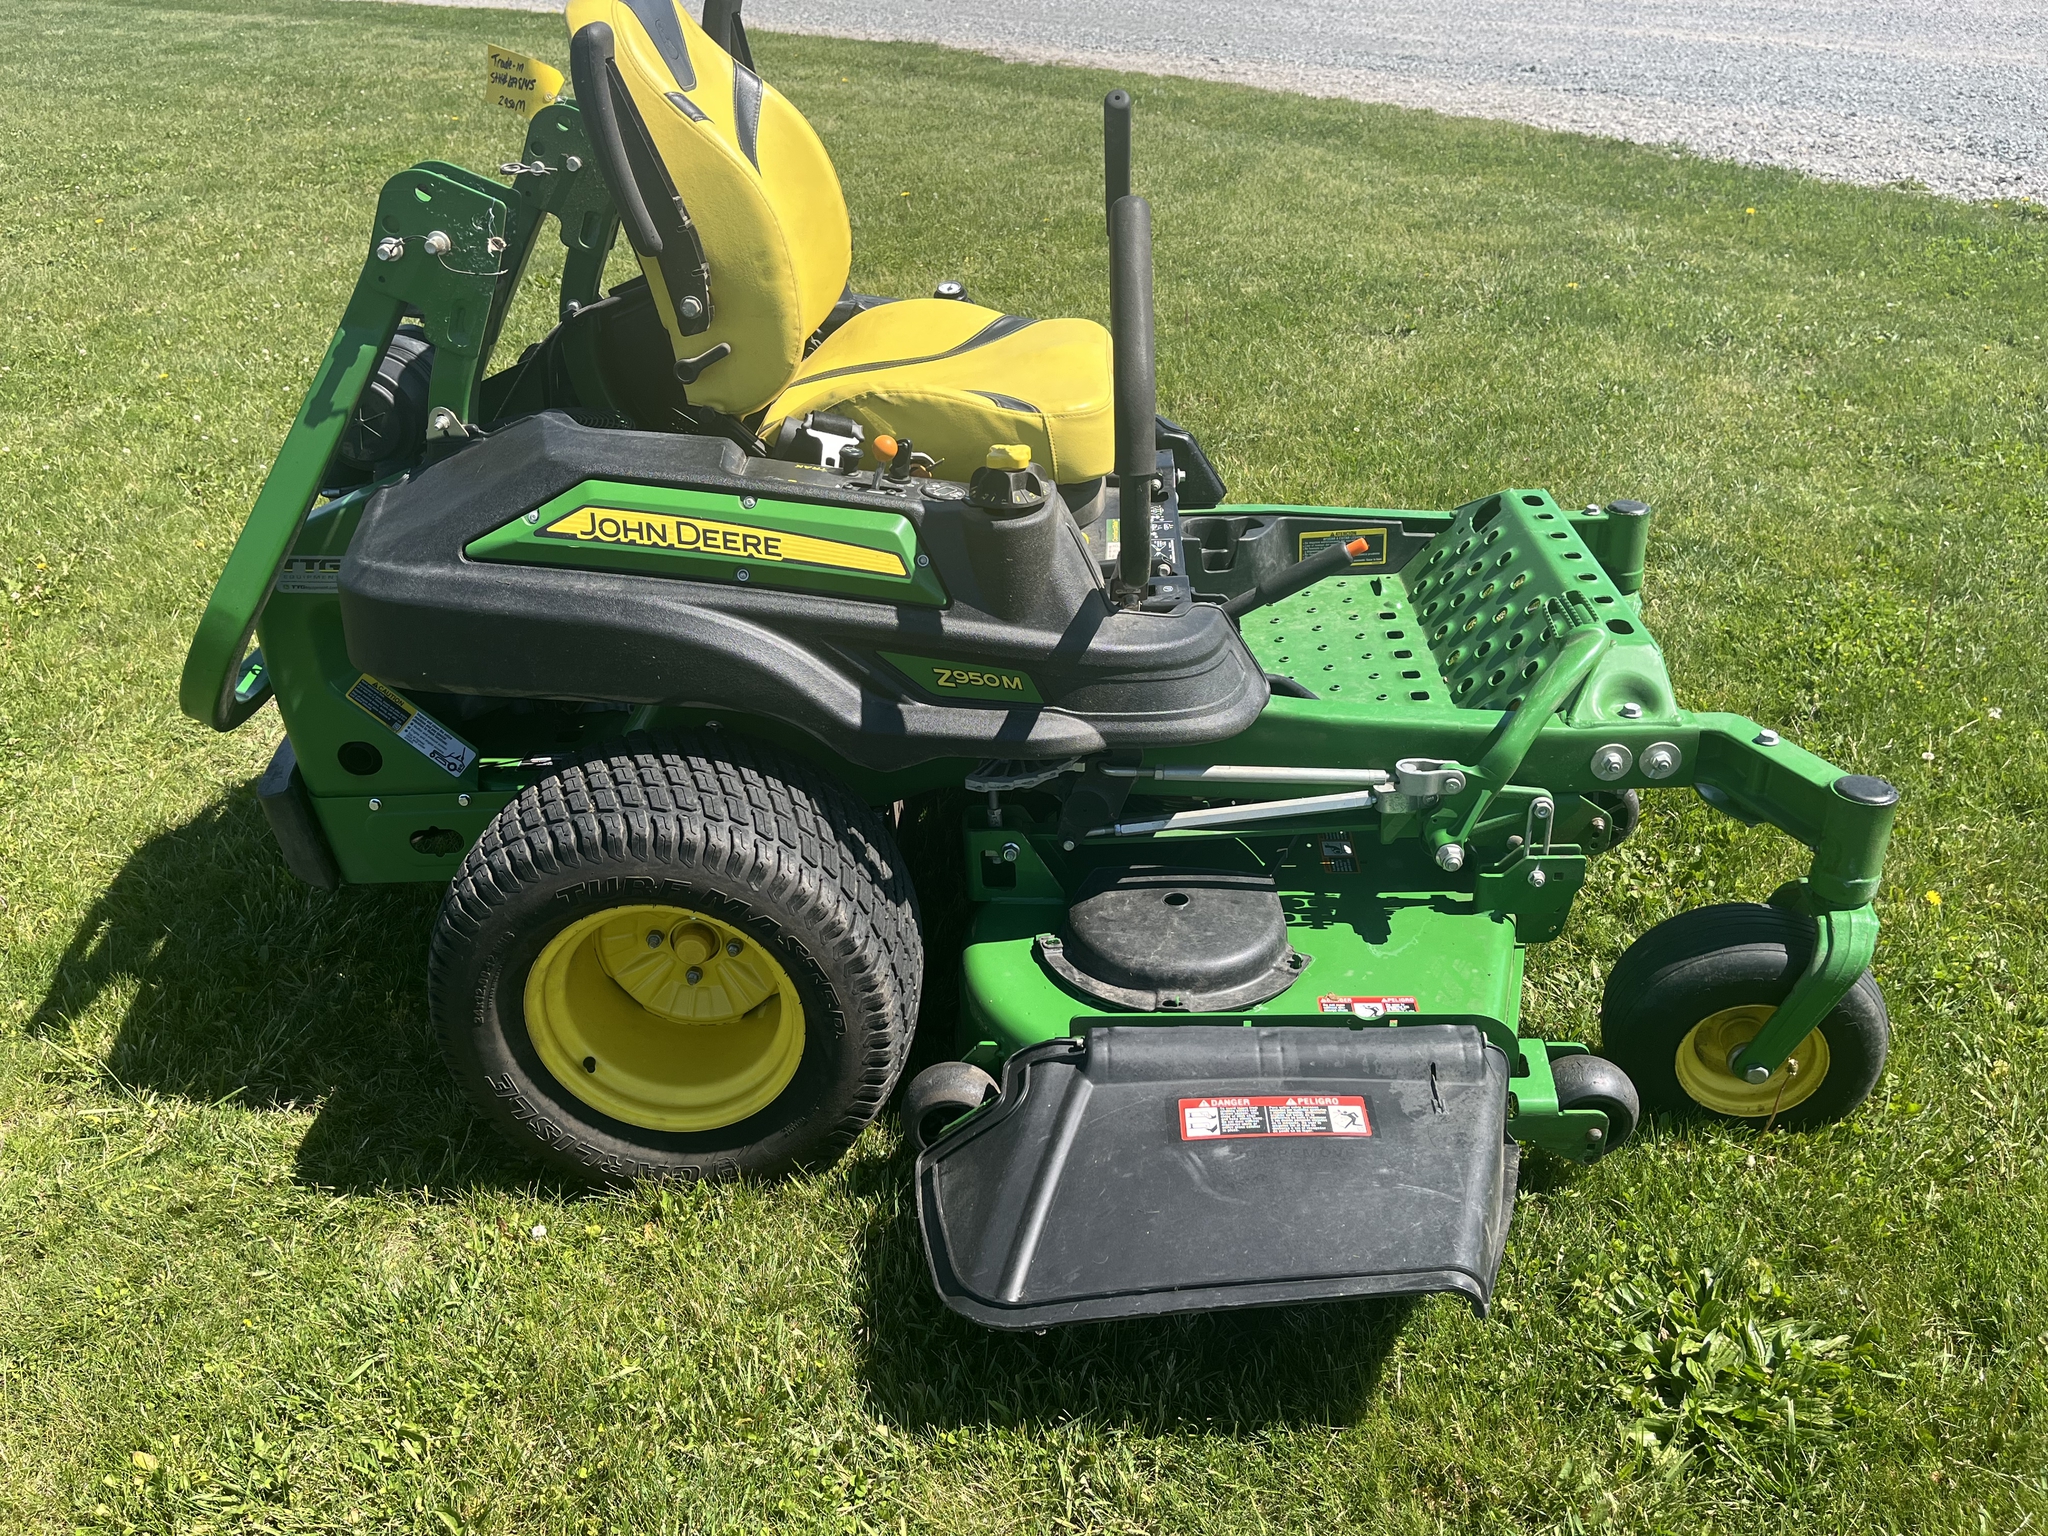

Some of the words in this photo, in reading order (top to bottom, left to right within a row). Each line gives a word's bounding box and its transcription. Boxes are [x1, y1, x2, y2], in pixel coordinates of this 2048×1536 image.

[580, 512, 667, 543] JOHN
[675, 521, 782, 557] DEERE
[932, 667, 1024, 691] Z950M
[378, 685, 405, 707] CAUTION
[556, 875, 693, 906] TURF
[1210, 1098, 1251, 1107] DANGER
[1297, 1097, 1339, 1106] PELIGRO
